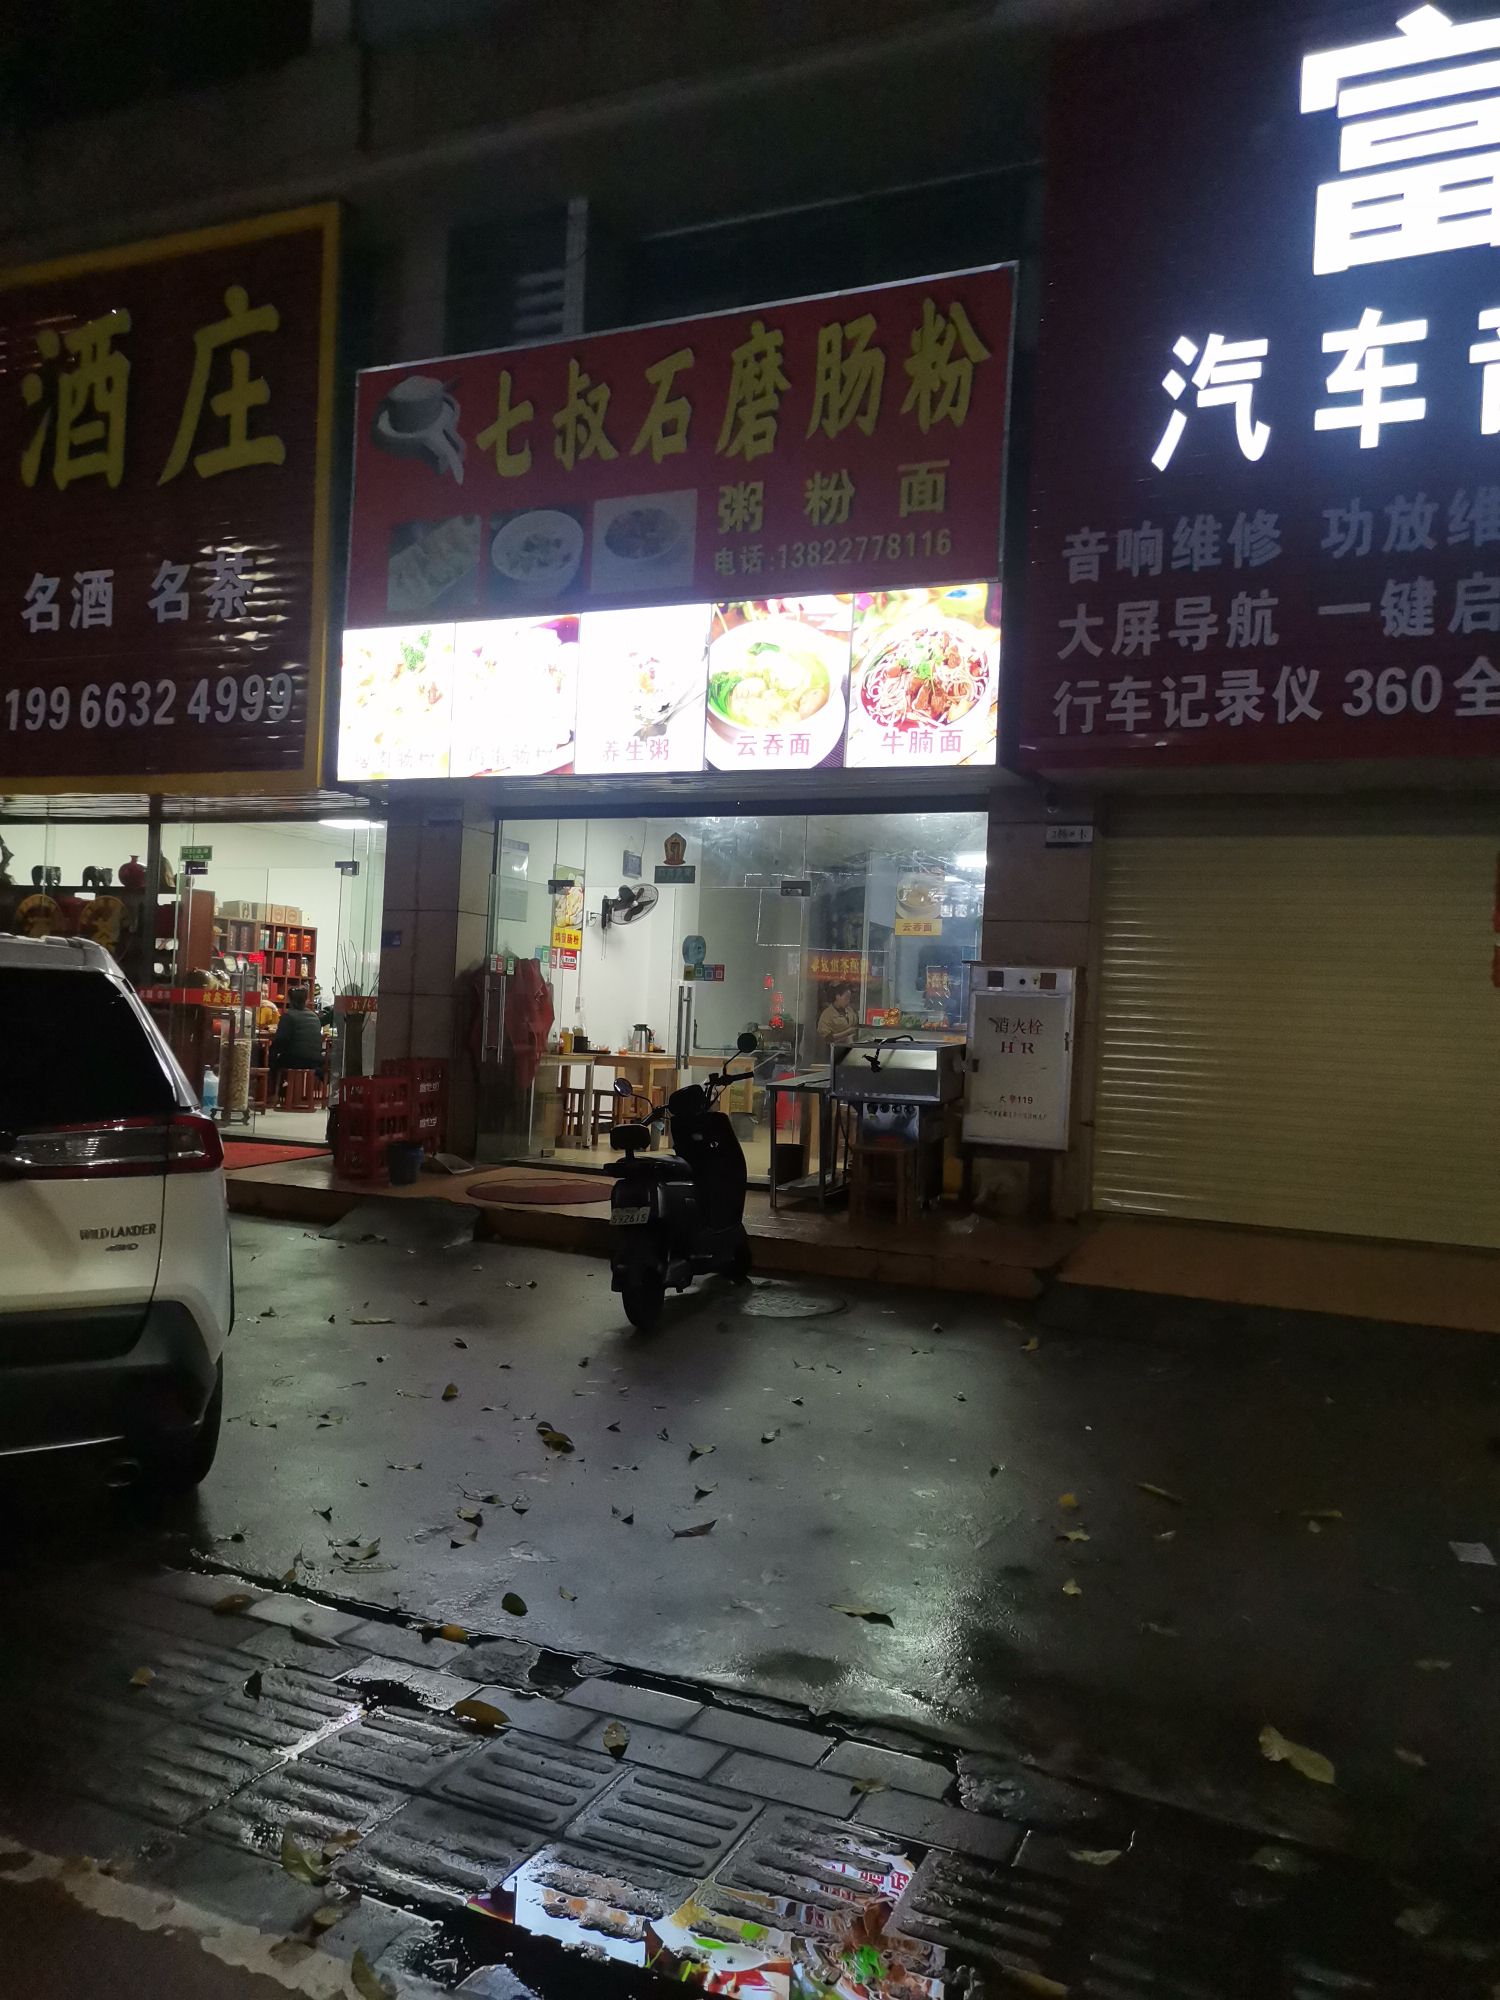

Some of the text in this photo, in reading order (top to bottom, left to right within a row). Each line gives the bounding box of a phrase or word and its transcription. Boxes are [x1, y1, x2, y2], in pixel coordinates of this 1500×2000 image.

[21, 285, 286, 491] 酒庄
[475, 297, 992, 478] 七叔石磨肠粉
[1151, 308, 1500, 472] 汽车
[1061, 507, 1284, 584] 音响维修
[21, 568, 114, 634] 名酒
[1056, 588, 1280, 661] 大屏导航
[5, 686, 69, 731] 199
[79, 680, 176, 727] 6632
[1051, 664, 1324, 735] 行车记录仪
[602, 738, 670, 763] 养生粥
[736, 732, 812, 756] 云吞面
[880, 729, 964, 755] 牛腩面
